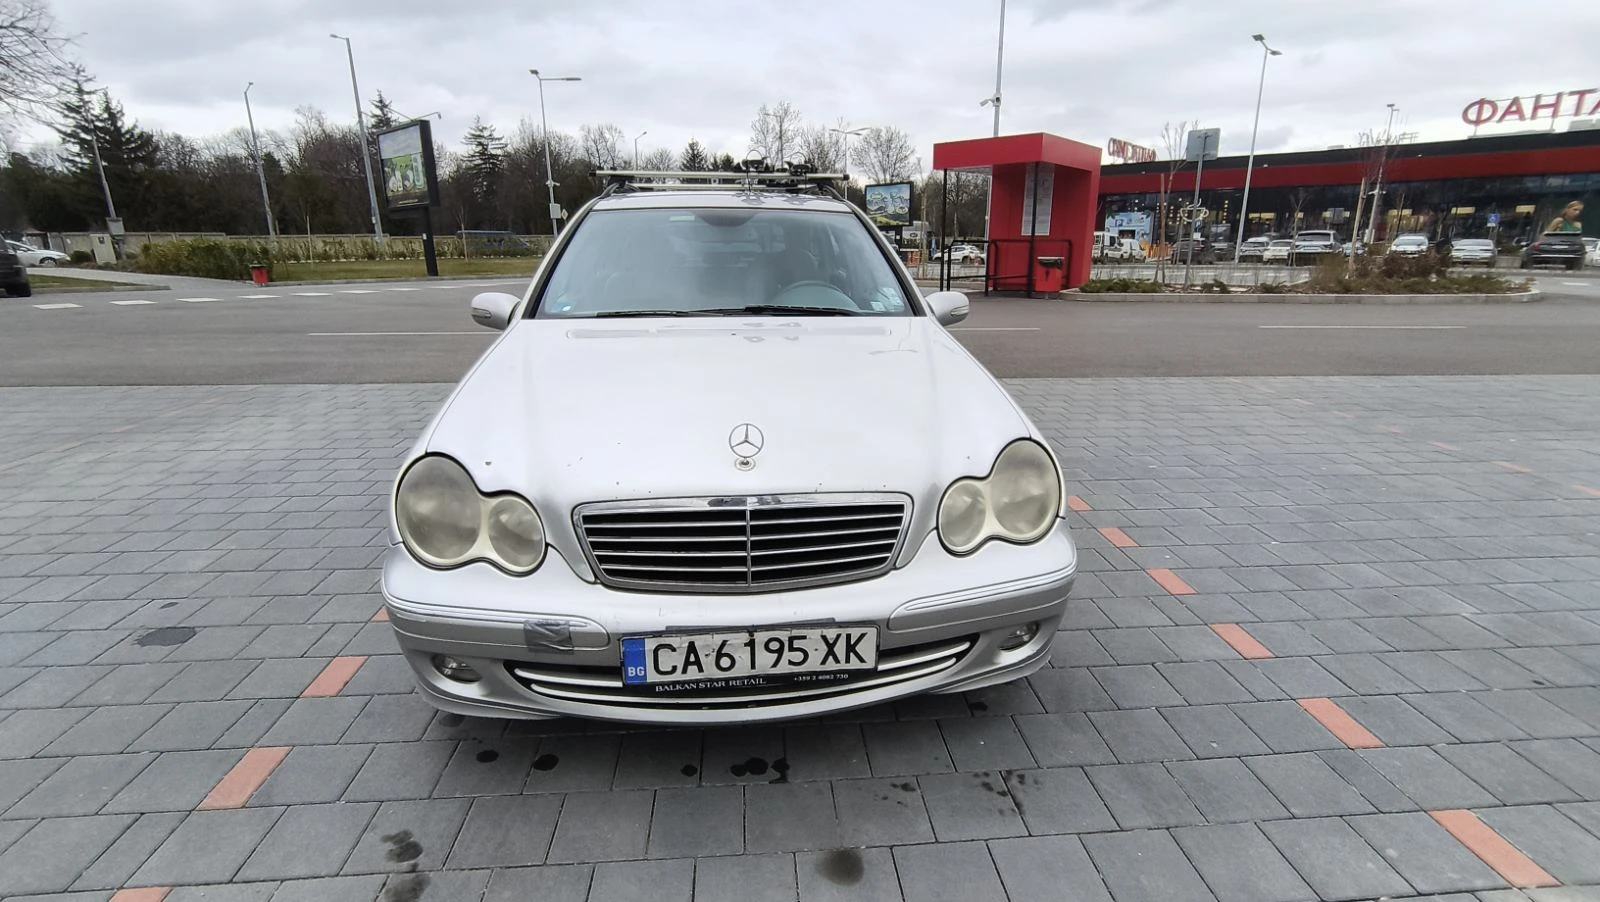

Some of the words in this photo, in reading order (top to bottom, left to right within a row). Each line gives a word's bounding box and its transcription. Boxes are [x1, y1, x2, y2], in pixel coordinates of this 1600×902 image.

[652, 640, 704, 675] CA
[714, 634, 810, 673] 6195
[819, 631, 869, 666] XK
[627, 666, 645, 676] BG
[655, 682, 697, 692] BALKAN
[698, 680, 726, 689] STAR
[729, 678, 767, 687] RETAIL
